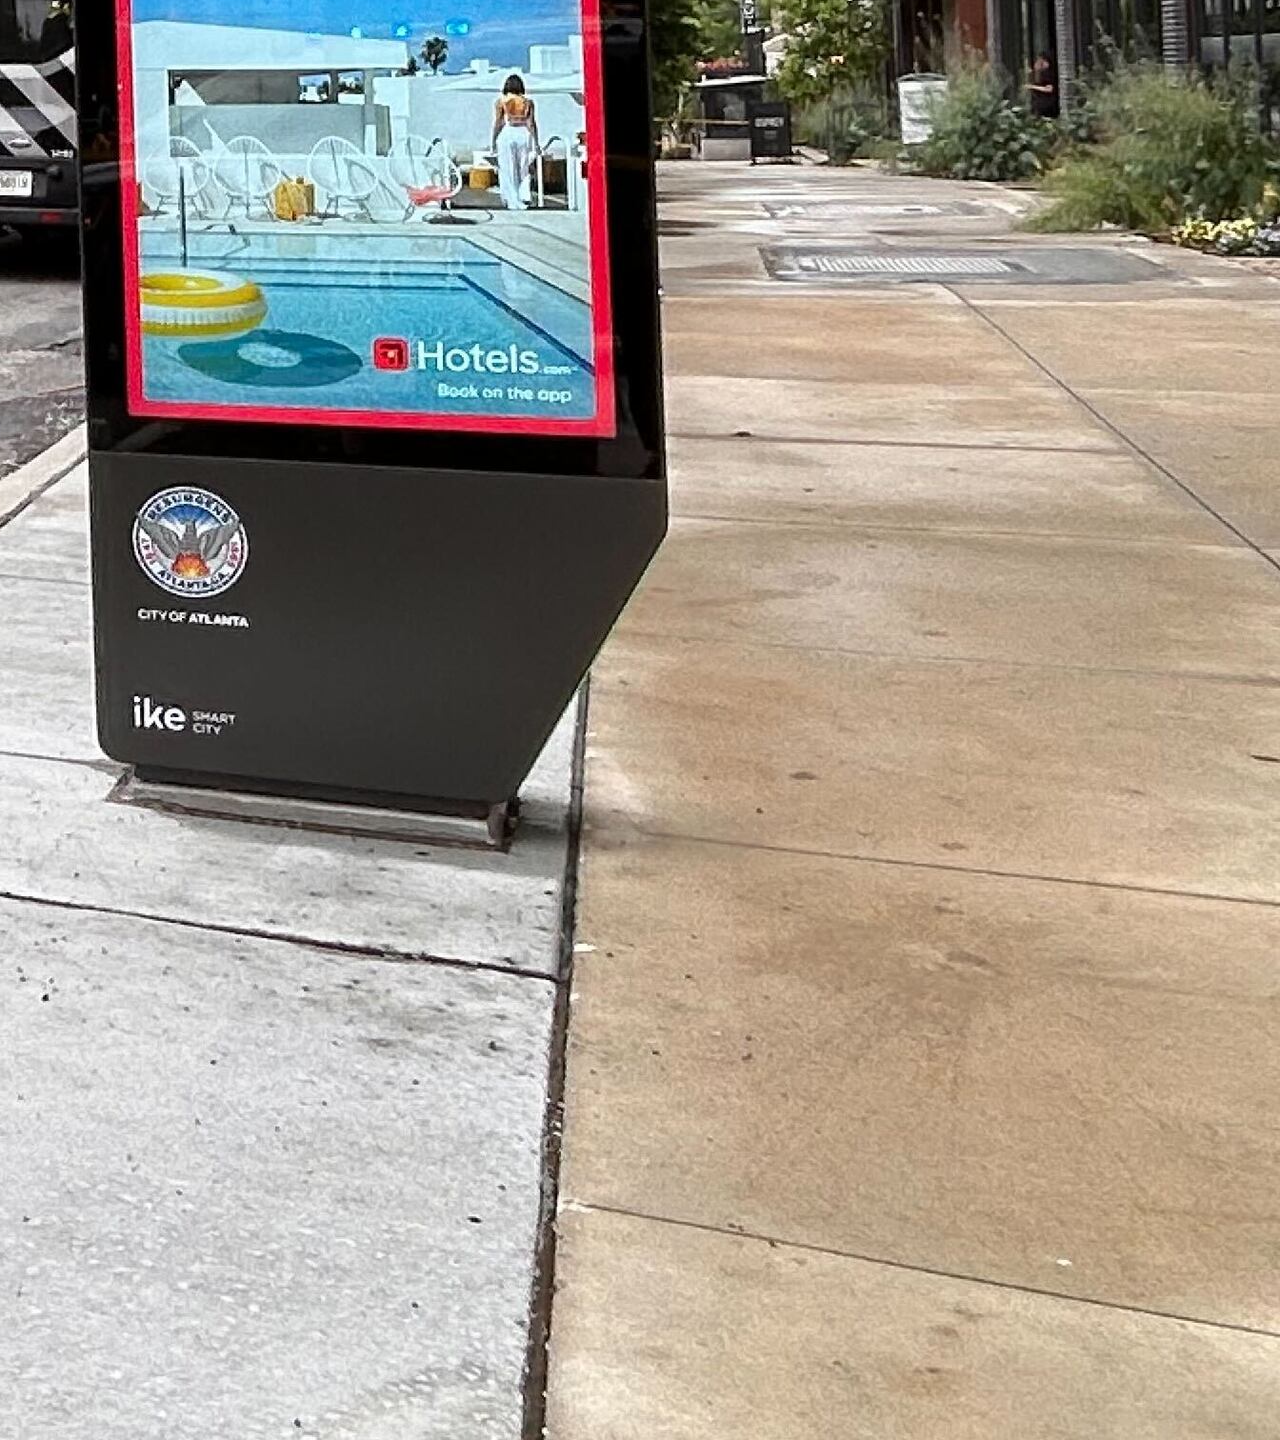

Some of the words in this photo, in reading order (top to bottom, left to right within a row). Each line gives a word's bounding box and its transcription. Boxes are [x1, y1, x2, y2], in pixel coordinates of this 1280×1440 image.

[438, 383, 480, 399] Book
[483, 387, 503, 400] on
[507, 386, 534, 401] the
[538, 389, 572, 404] app
[137, 608, 167, 621] CITY
[168, 610, 187, 623] OF
[189, 613, 249, 628] ATLANTA
[133, 695, 186, 731] ike
[192, 710, 236, 725] SMART
[192, 722, 222, 735] CITY
